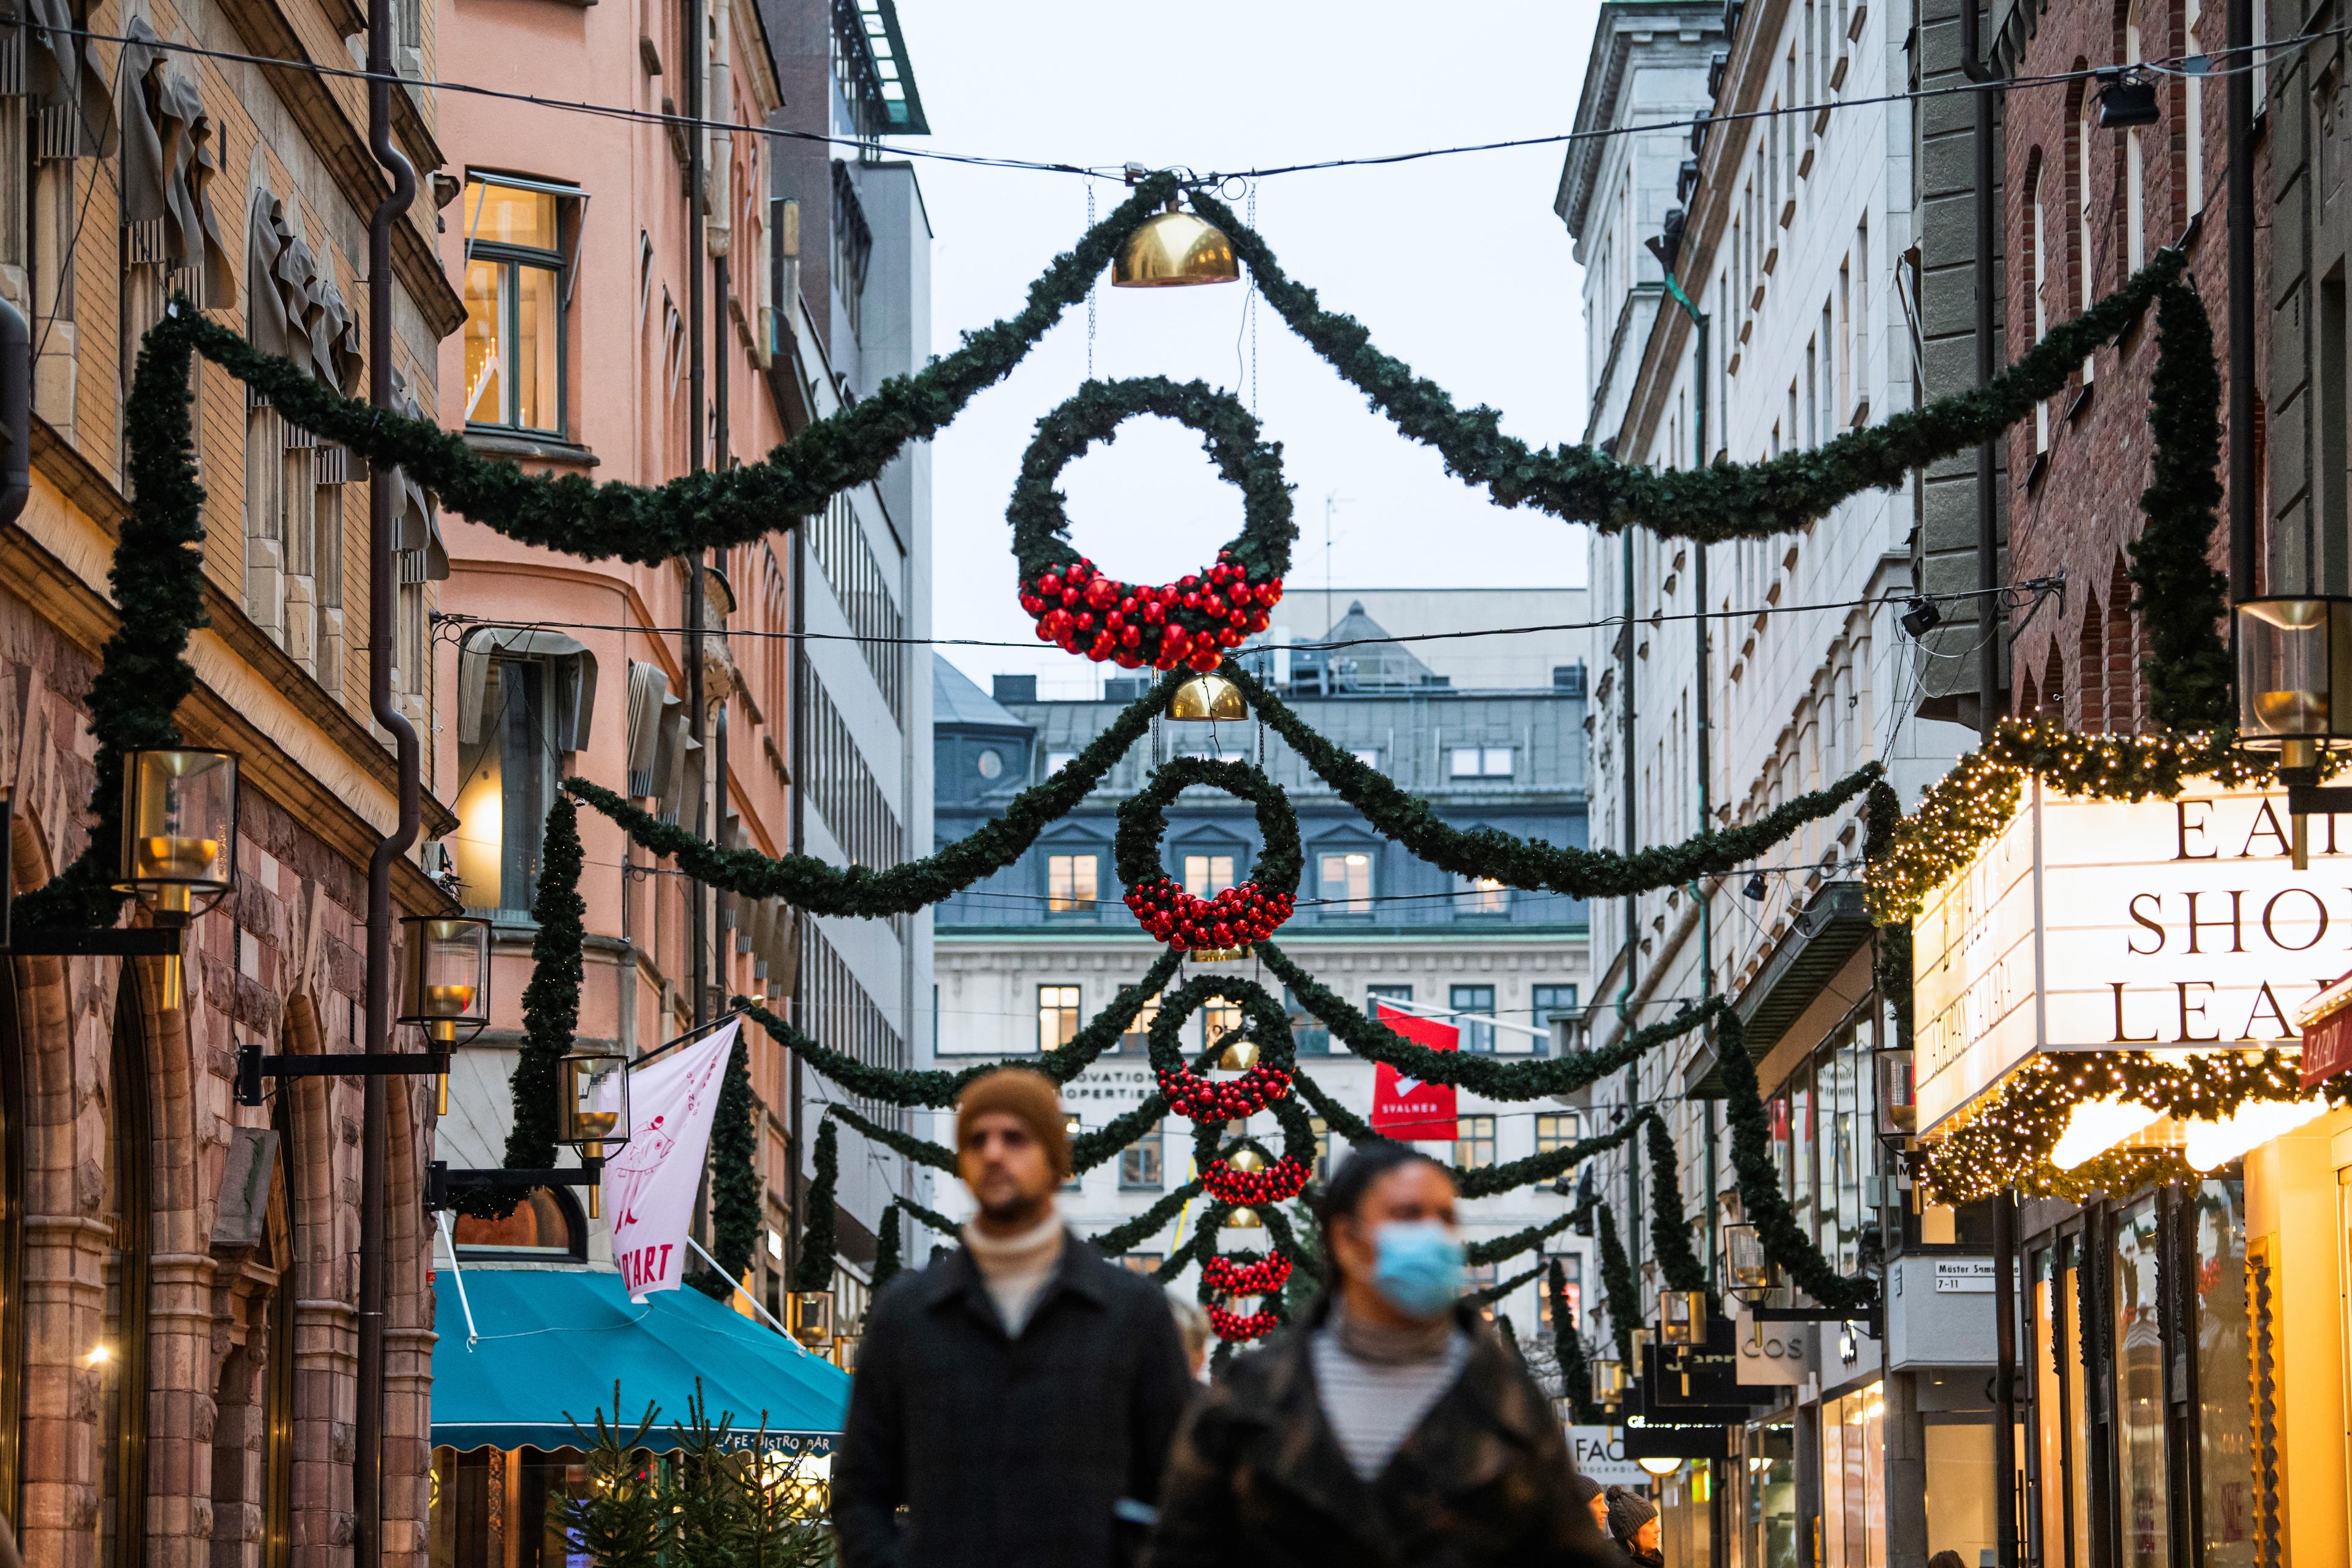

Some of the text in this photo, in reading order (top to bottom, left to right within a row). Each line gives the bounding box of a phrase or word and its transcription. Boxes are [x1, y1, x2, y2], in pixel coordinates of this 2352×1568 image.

[2128, 888, 2352, 956] SHO
[2105, 979, 2332, 1042] LEA
[1939, 1265, 1969, 1273] Mäster
[1938, 1280, 1959, 1289] 7-11
[1743, 1338, 1803, 1359] COS
